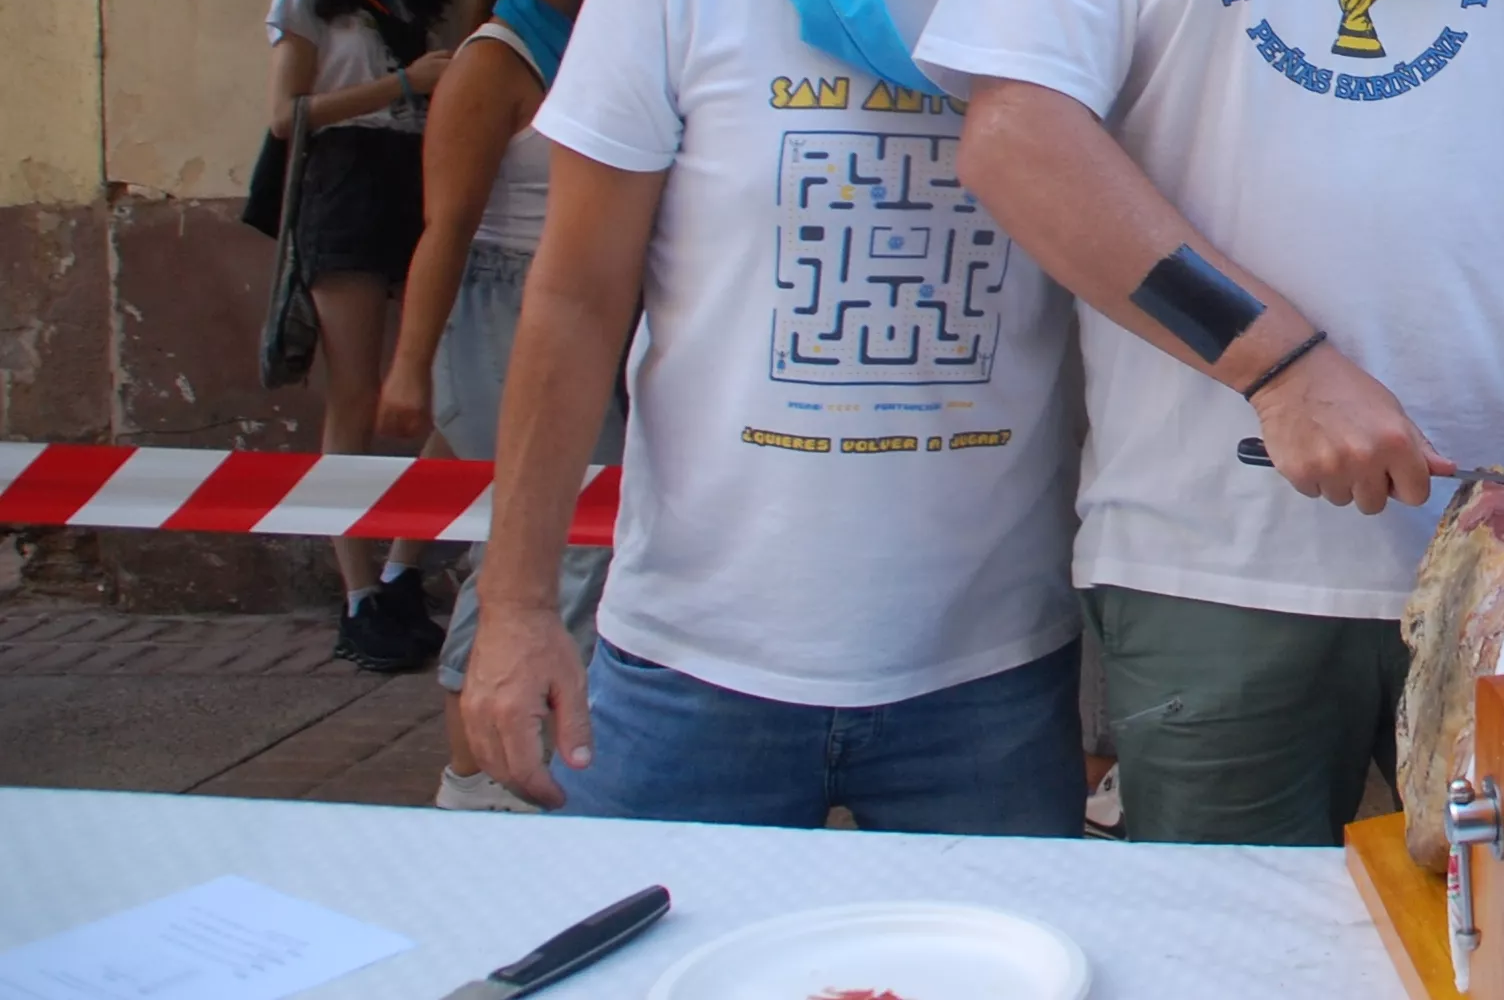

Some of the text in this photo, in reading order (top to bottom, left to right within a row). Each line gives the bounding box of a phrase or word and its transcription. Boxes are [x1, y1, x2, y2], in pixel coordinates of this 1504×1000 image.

[1245, 18, 1469, 101] PEÑAS SARIÑENA
[770, 76, 850, 109] SAN
[841, 436, 918, 454] VOLVER
